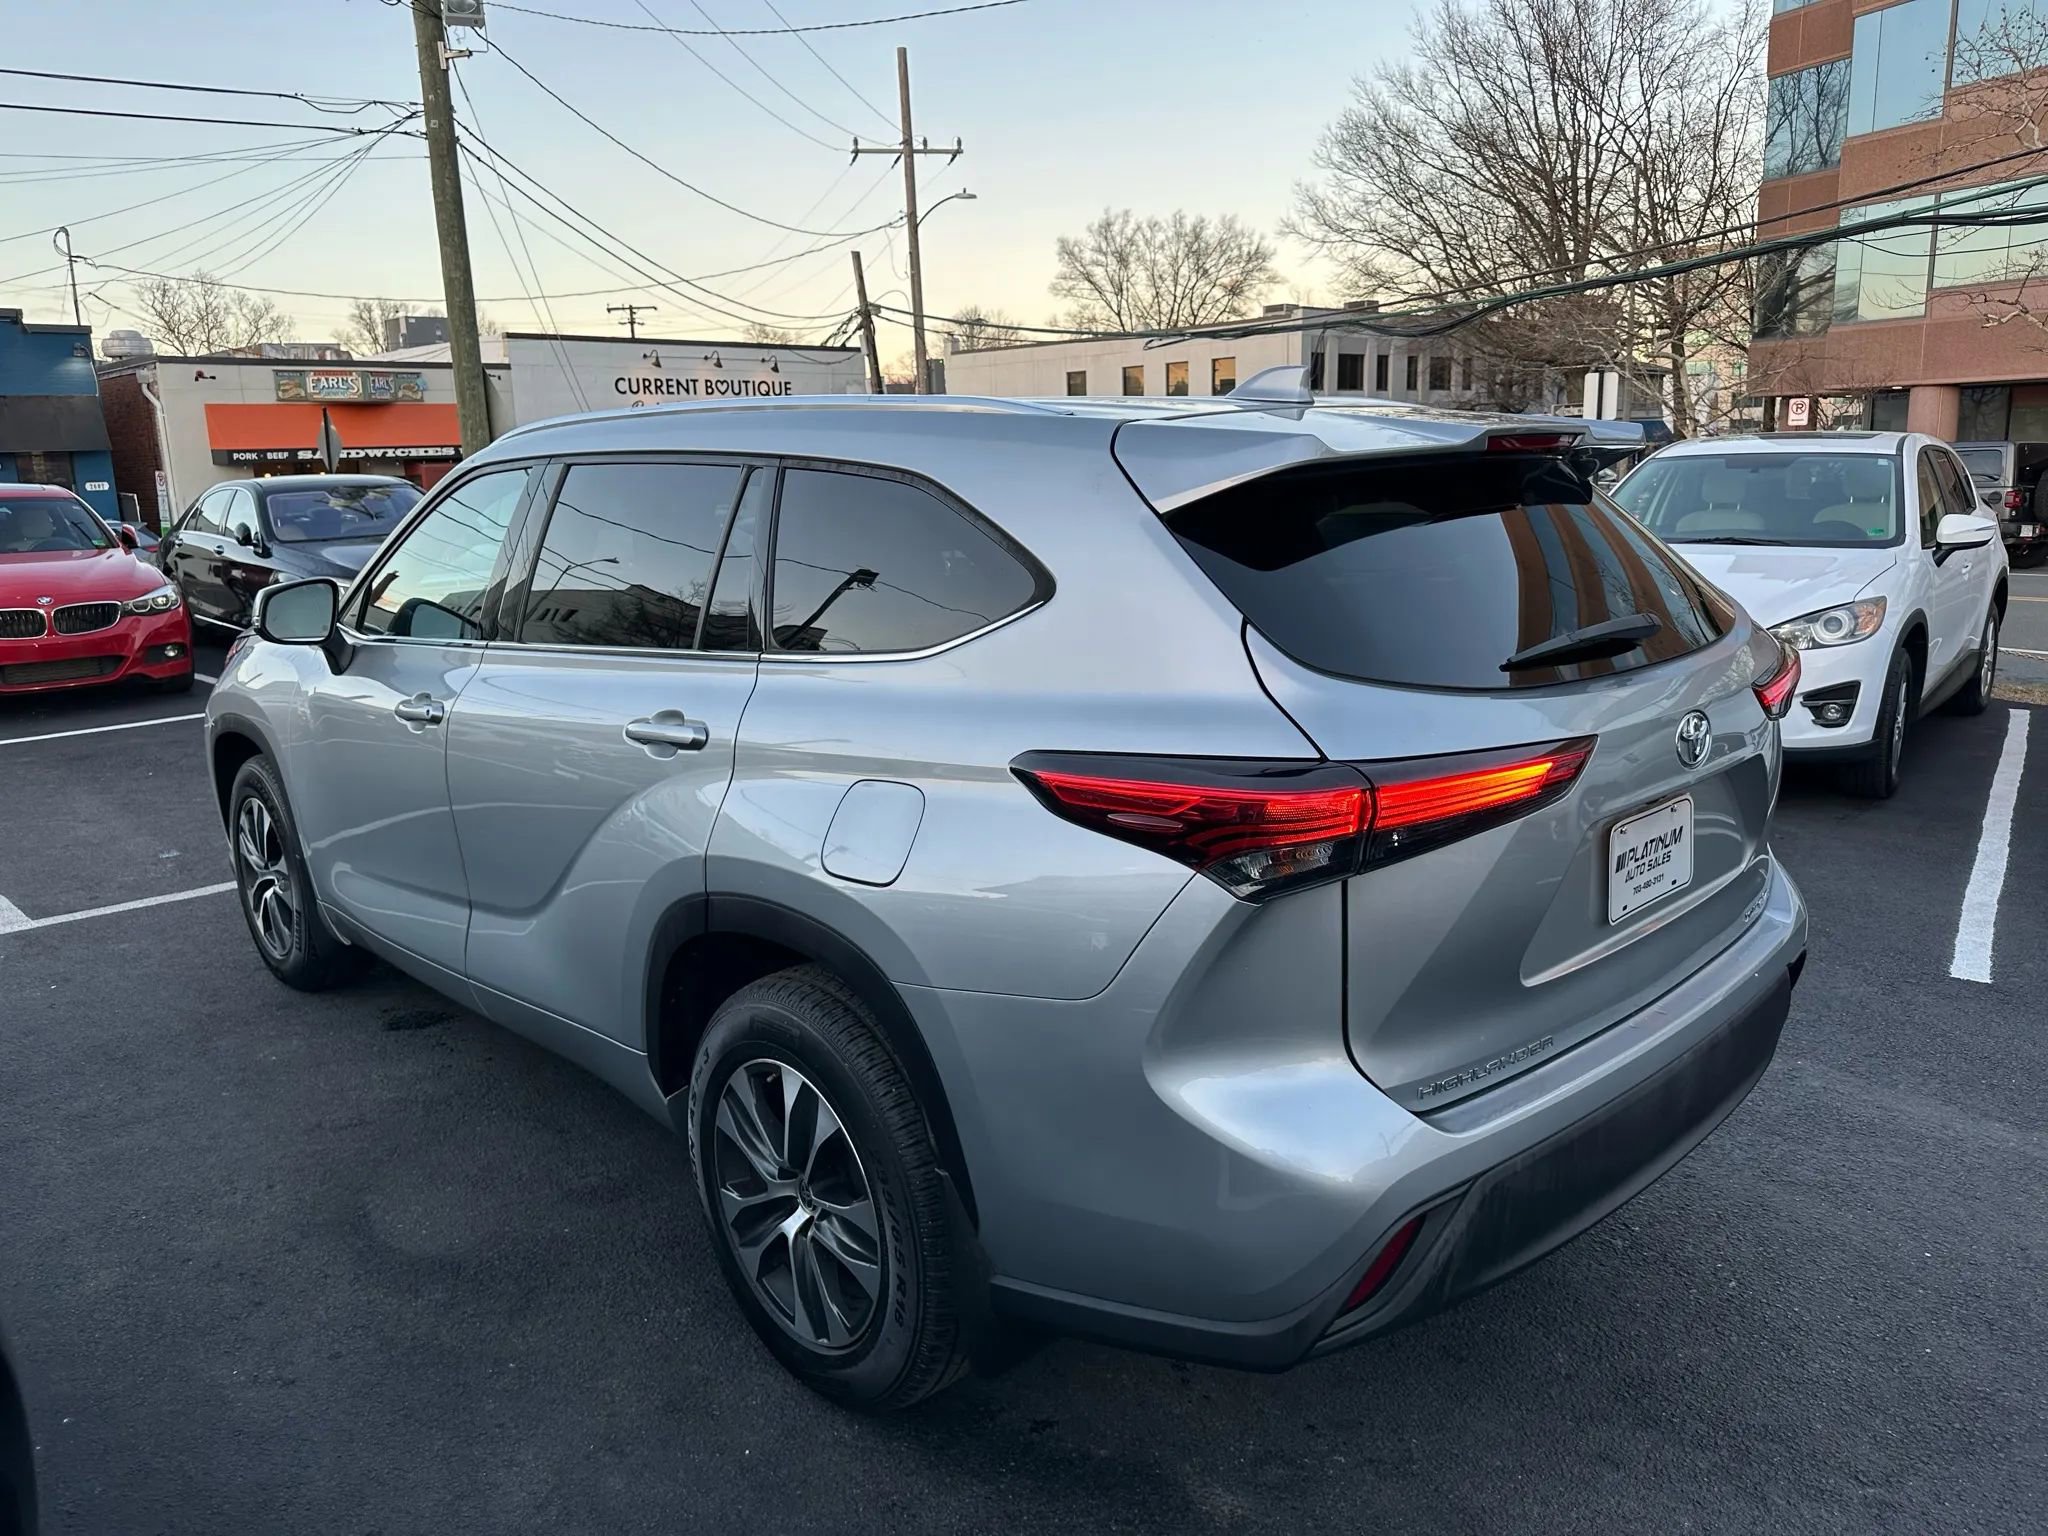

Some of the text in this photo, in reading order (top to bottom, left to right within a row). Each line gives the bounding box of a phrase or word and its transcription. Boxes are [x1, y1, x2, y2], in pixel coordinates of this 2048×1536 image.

[309, 376, 359, 394] EARL'S
[370, 377, 395, 394] EARL'S
[614, 377, 699, 396] CURRENT
[233, 452, 258, 461] PORK
[266, 451, 289, 460] BEEF
[1626, 825, 1684, 868] PLATINUM
[1624, 850, 1672, 884] AUTO SALES
[1416, 1034, 1554, 1100] HIGHLANDER
